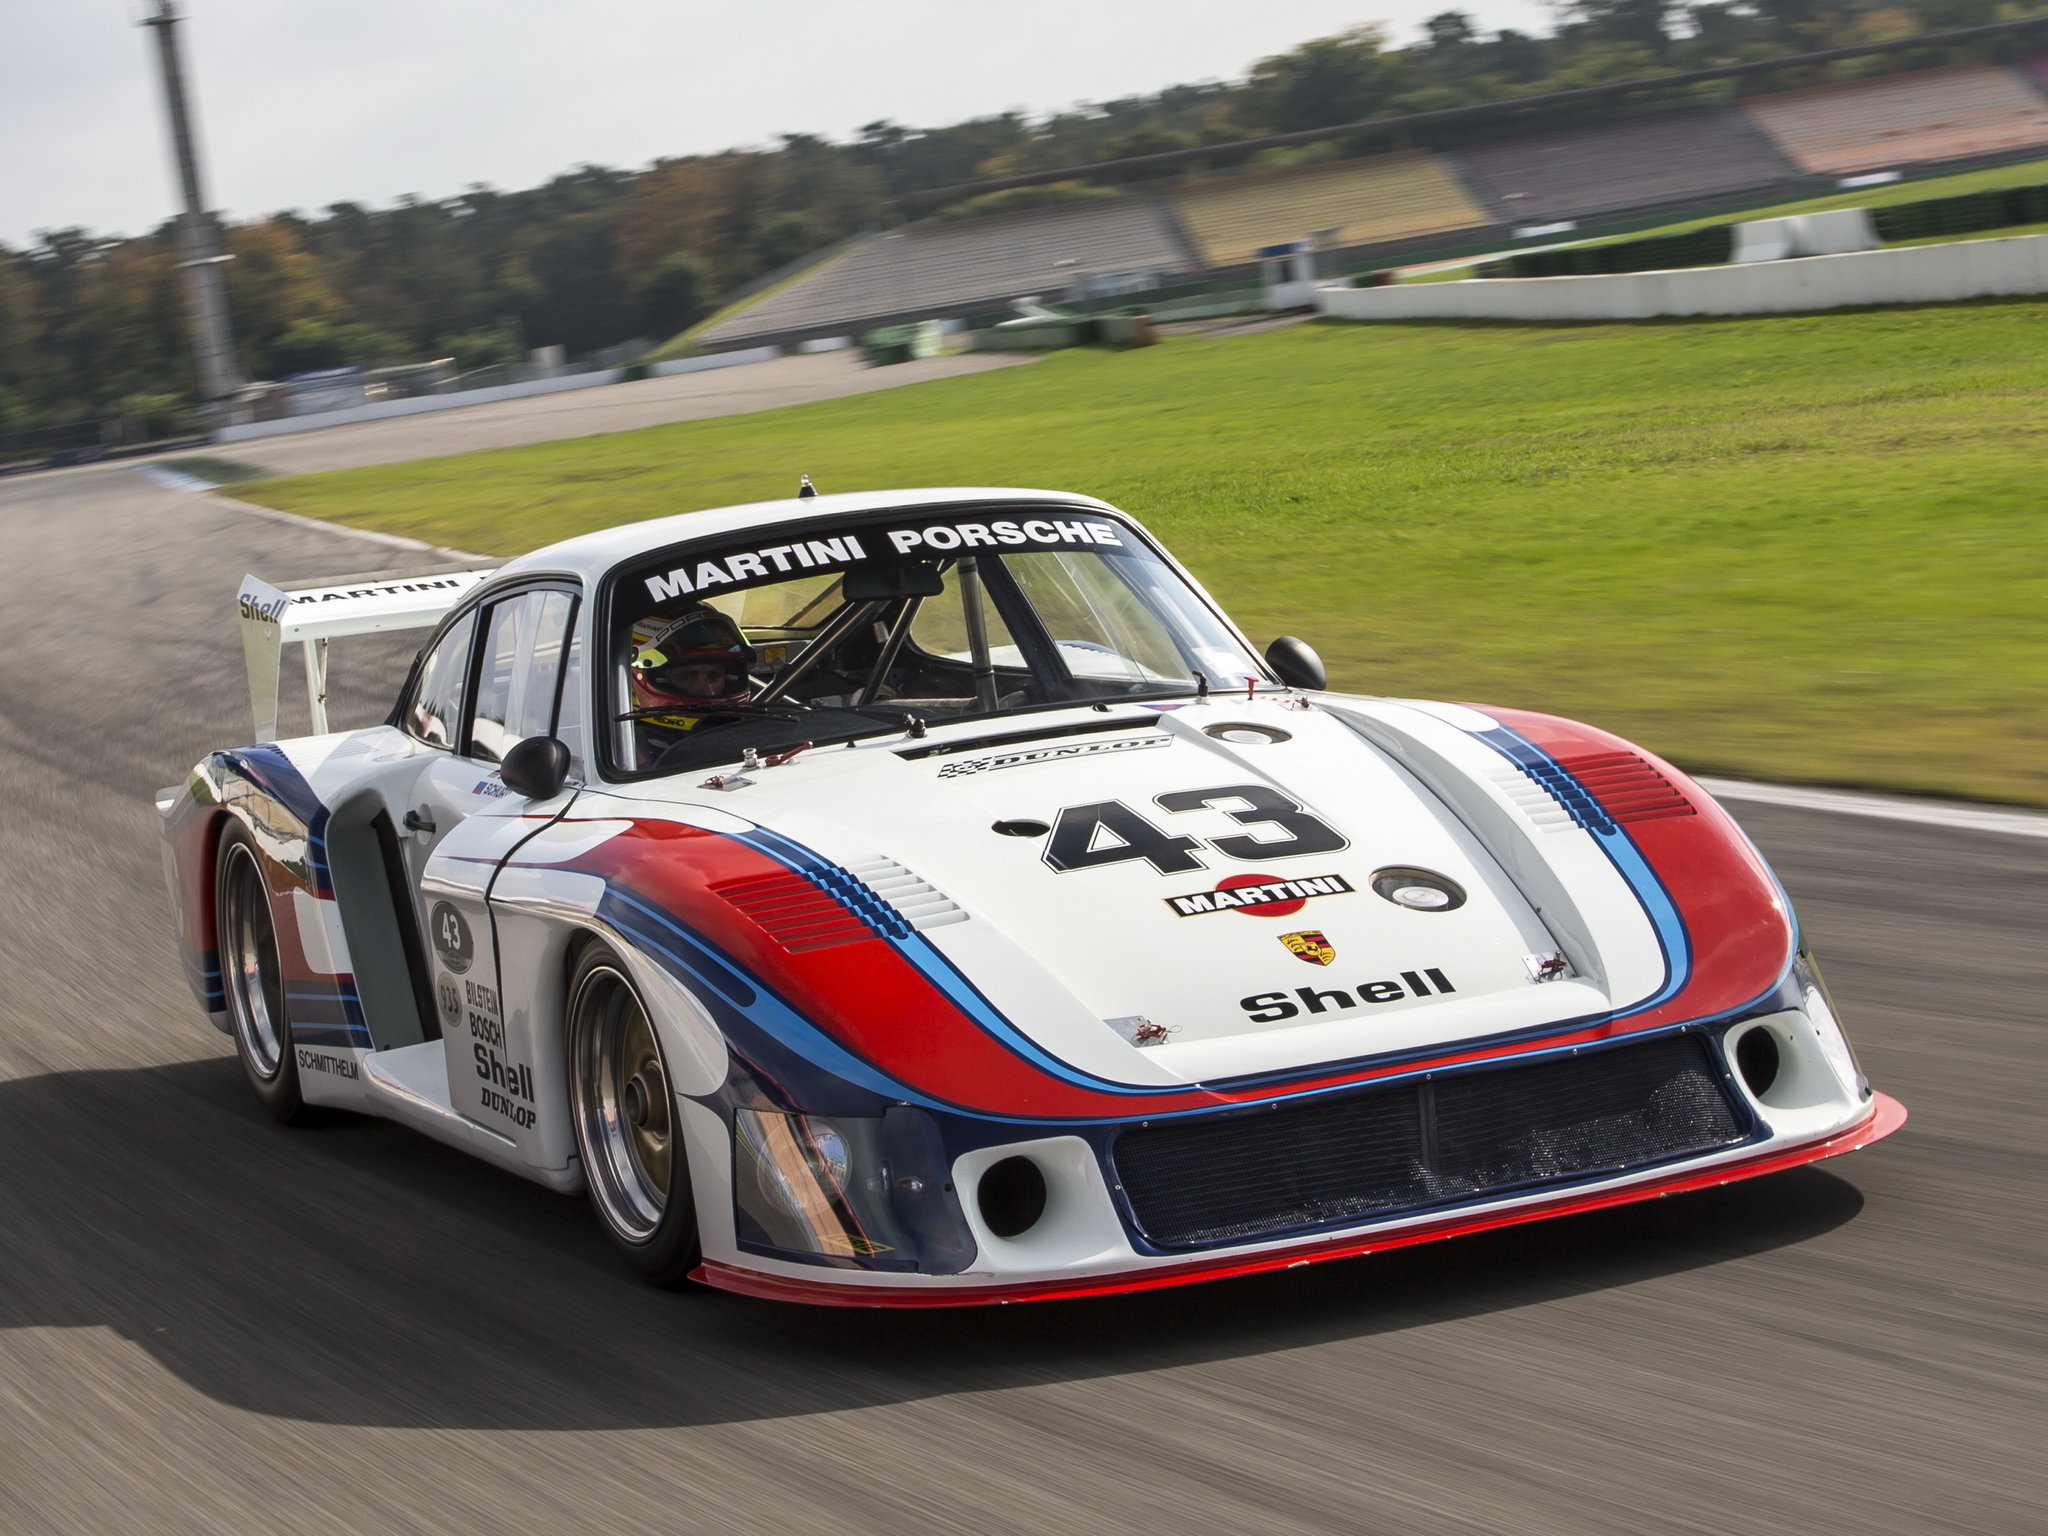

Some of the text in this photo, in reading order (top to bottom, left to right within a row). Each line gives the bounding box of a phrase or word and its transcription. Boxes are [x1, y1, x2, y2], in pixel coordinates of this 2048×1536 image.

[643, 519, 1124, 604] MARTINI PORSCHE
[239, 592, 287, 624] Shell
[289, 579, 462, 606] MARTINI
[986, 736, 1173, 768] DUNLOP
[1041, 784, 1351, 877] 43
[1176, 873, 1346, 916] MARTINI
[442, 912, 461, 950] 43
[440, 984, 460, 1015] 935
[465, 979, 499, 1017] BILSTEIN
[1239, 967, 1457, 1023] Shell
[468, 1010, 503, 1050] BOSCH
[298, 1048, 360, 1081] SCHMITTHELM
[473, 1042, 536, 1105] Shell
[480, 1086, 537, 1130] DUNLOP
